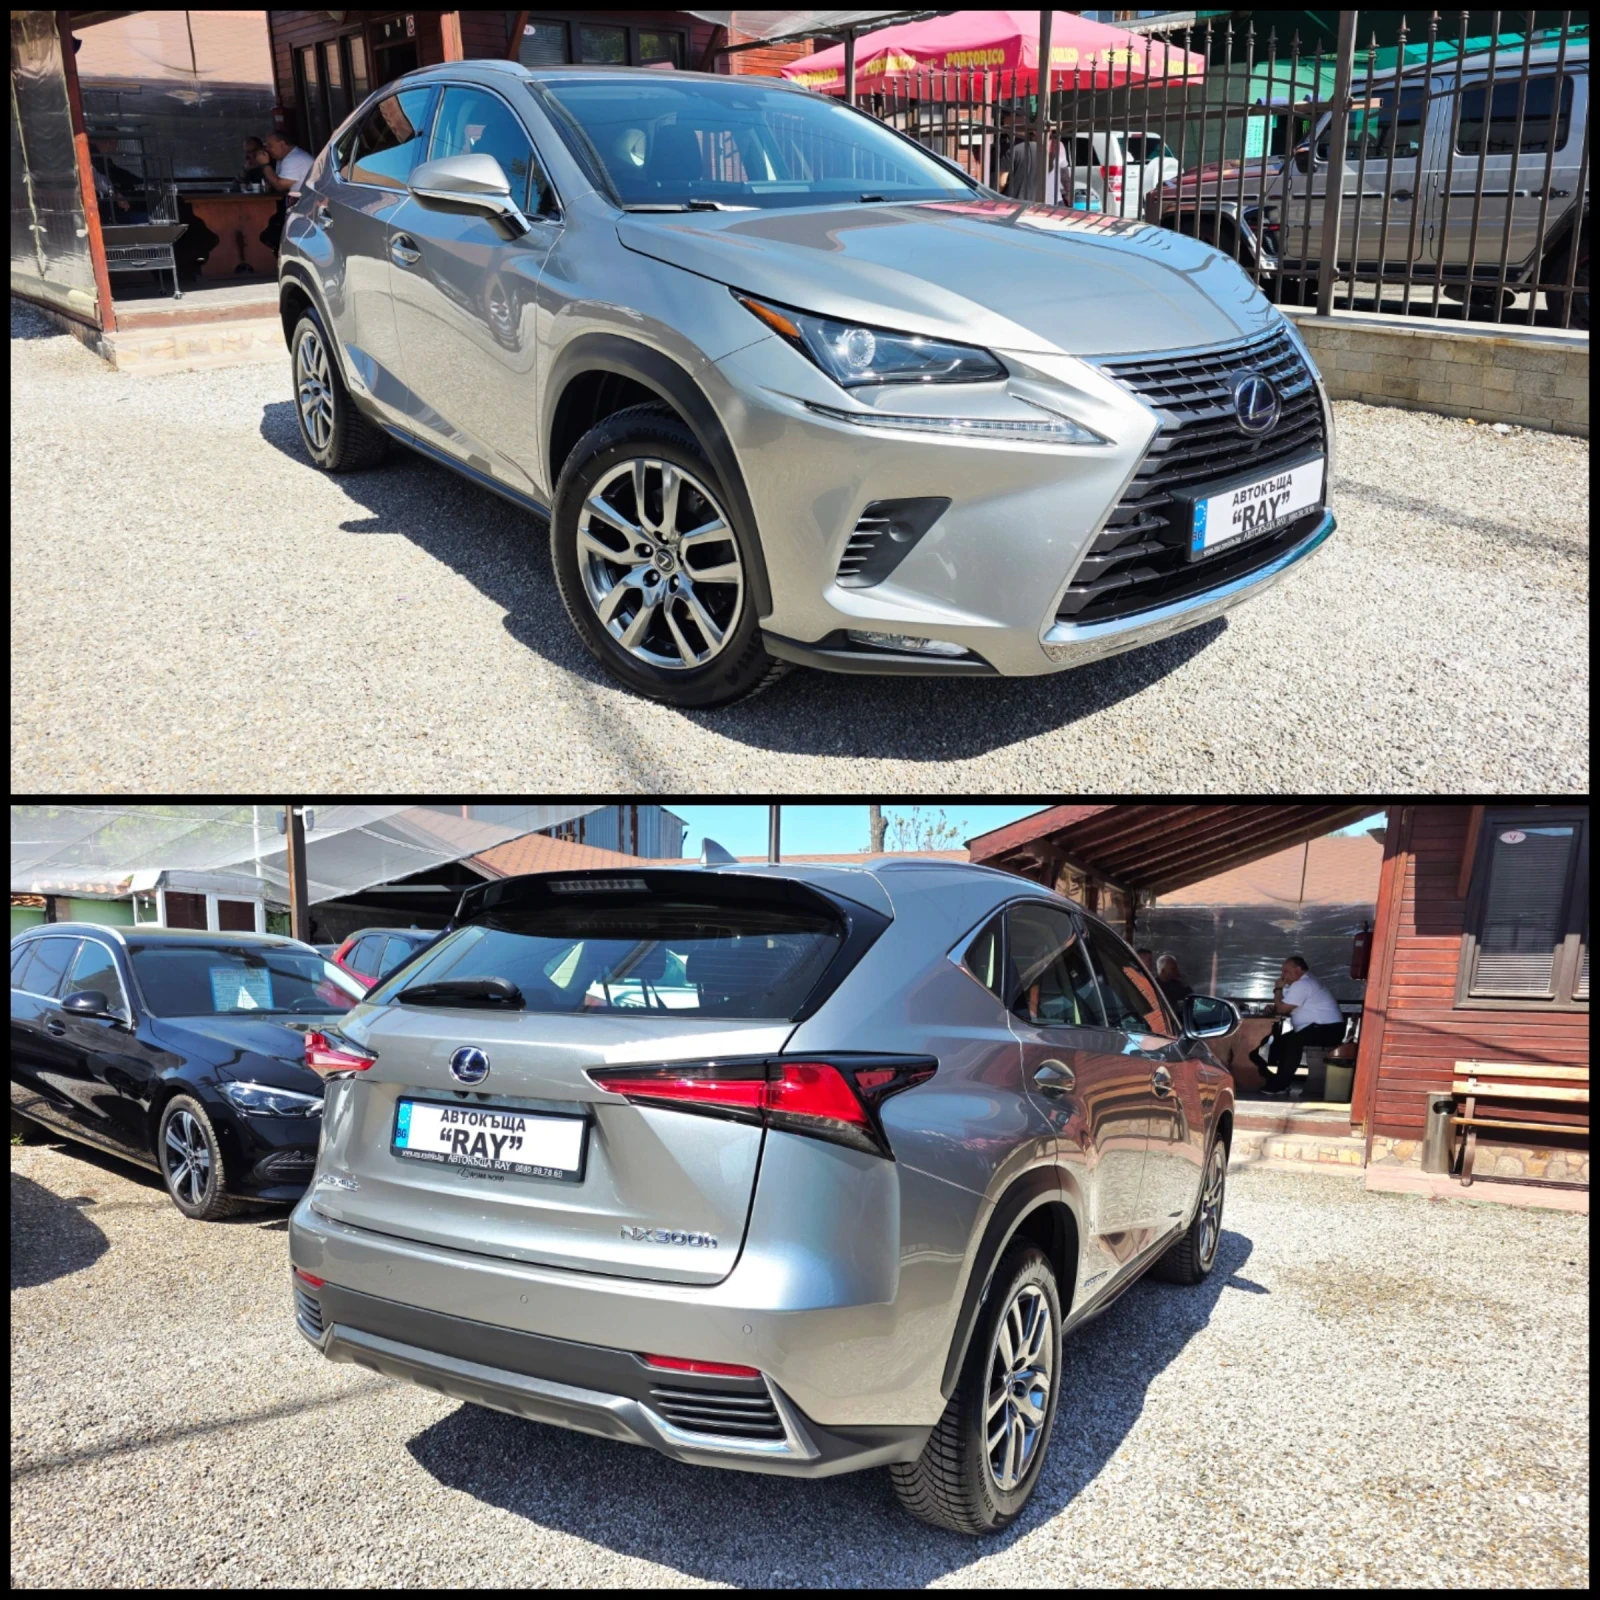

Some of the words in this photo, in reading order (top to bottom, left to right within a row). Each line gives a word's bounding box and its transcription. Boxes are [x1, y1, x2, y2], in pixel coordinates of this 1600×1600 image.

[946, 49, 1005, 67] PORTORICO
[1232, 474, 1292, 506] АВТОКЪЩА
[440, 1109, 526, 1133] АВТОКЪЩА
[396, 1128, 407, 1139] BG
[448, 1154, 492, 1169] АВТОКЪЩА
[494, 1160, 512, 1171] RAY
